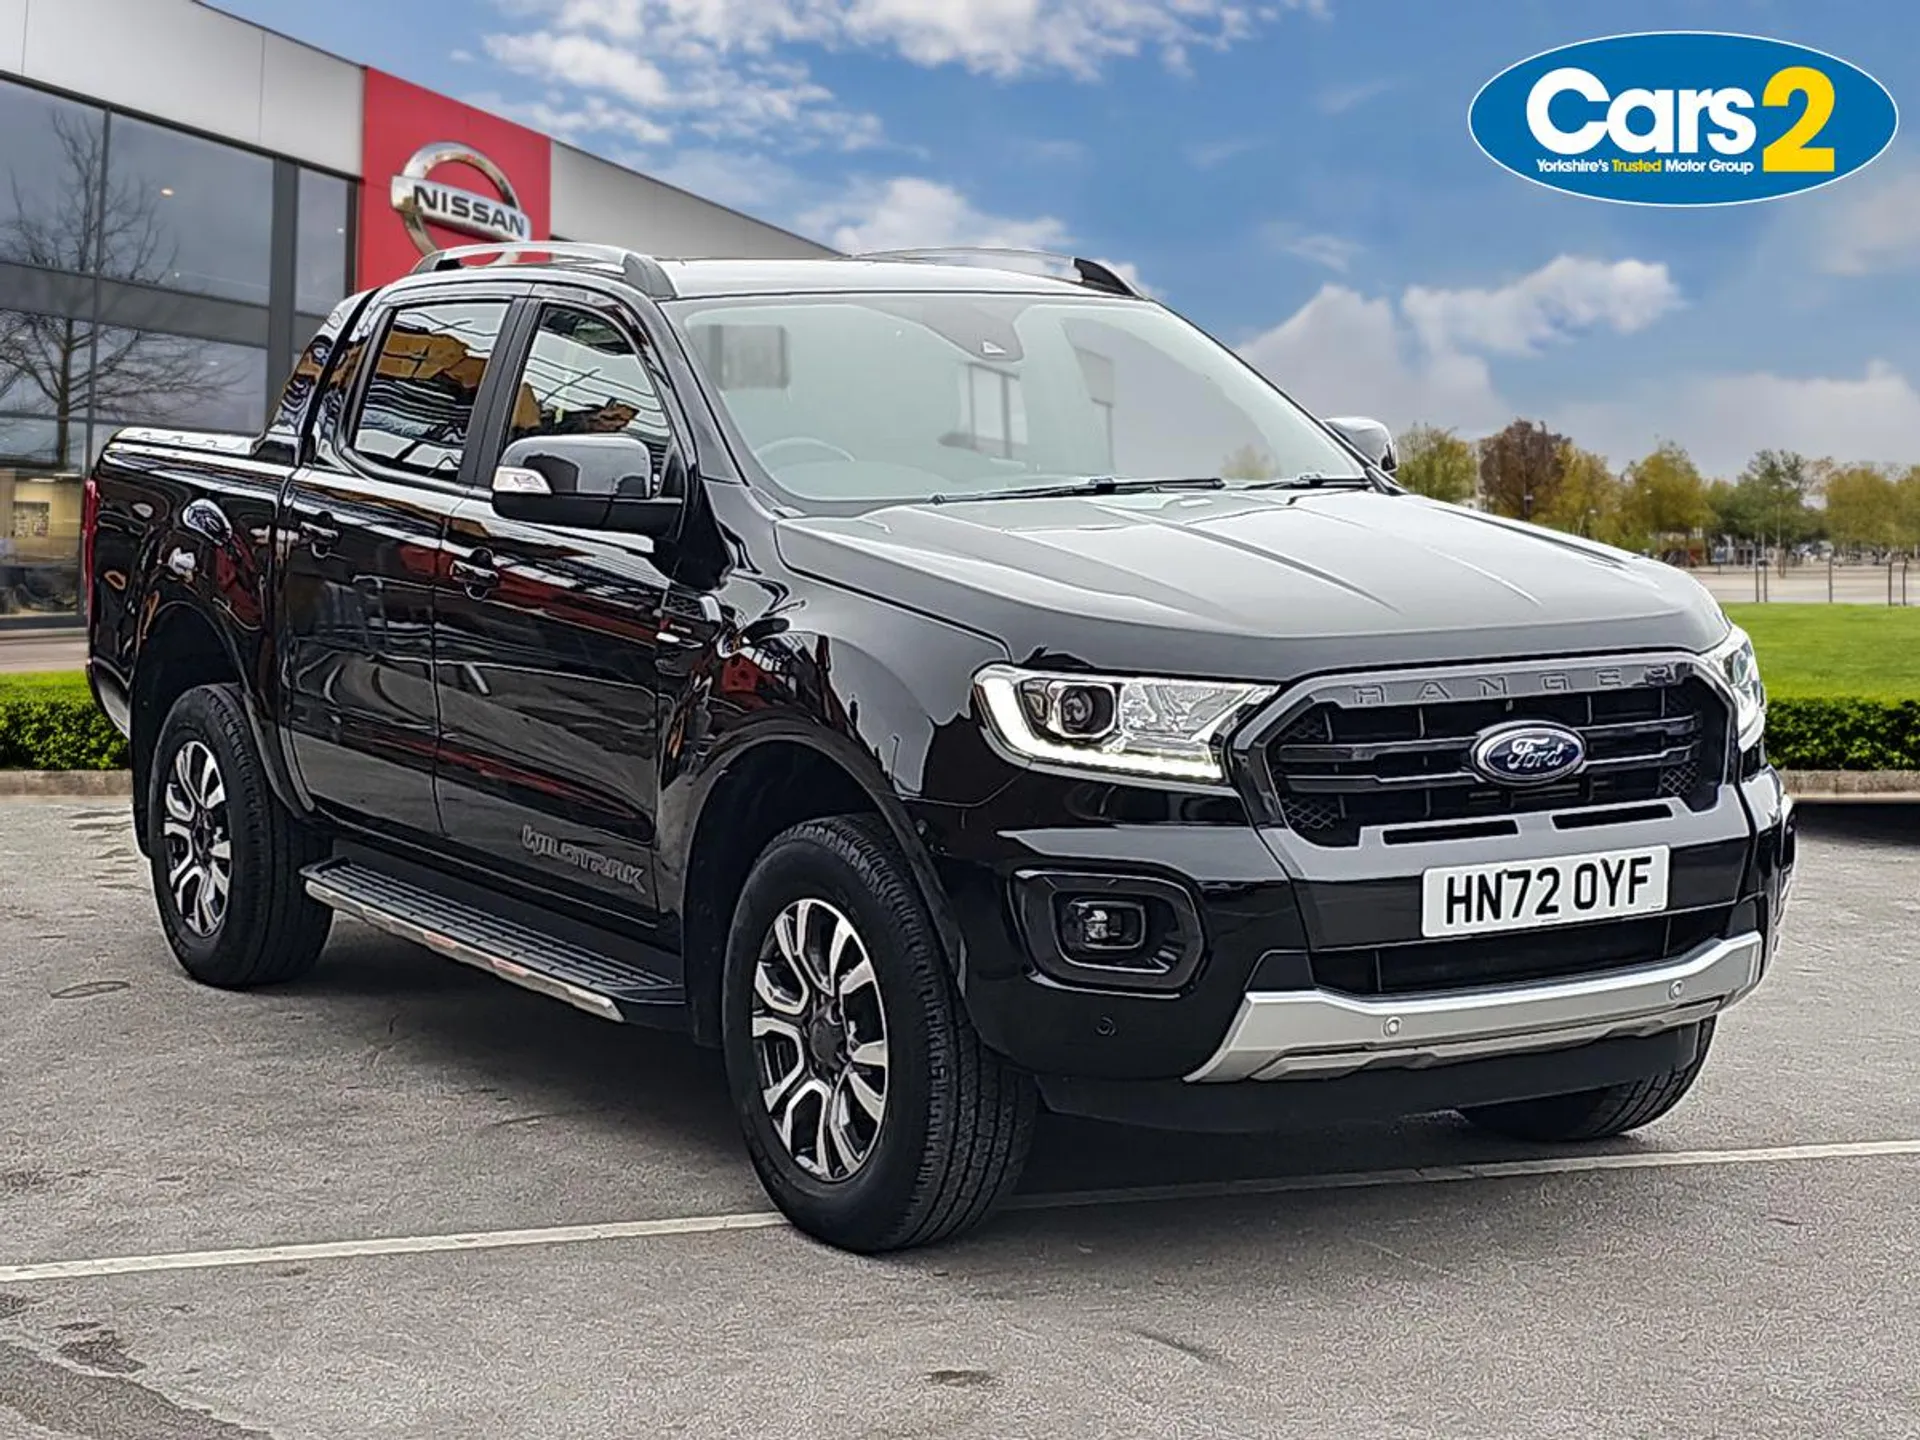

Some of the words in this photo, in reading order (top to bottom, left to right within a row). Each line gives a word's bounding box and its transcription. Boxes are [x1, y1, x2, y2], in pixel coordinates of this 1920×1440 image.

[413, 185, 525, 237] NISSAN
[1350, 663, 1676, 705] RANGER
[1507, 737, 1564, 770] Ford
[1446, 867, 1560, 925] HN72
[1574, 856, 1652, 910] OYF
